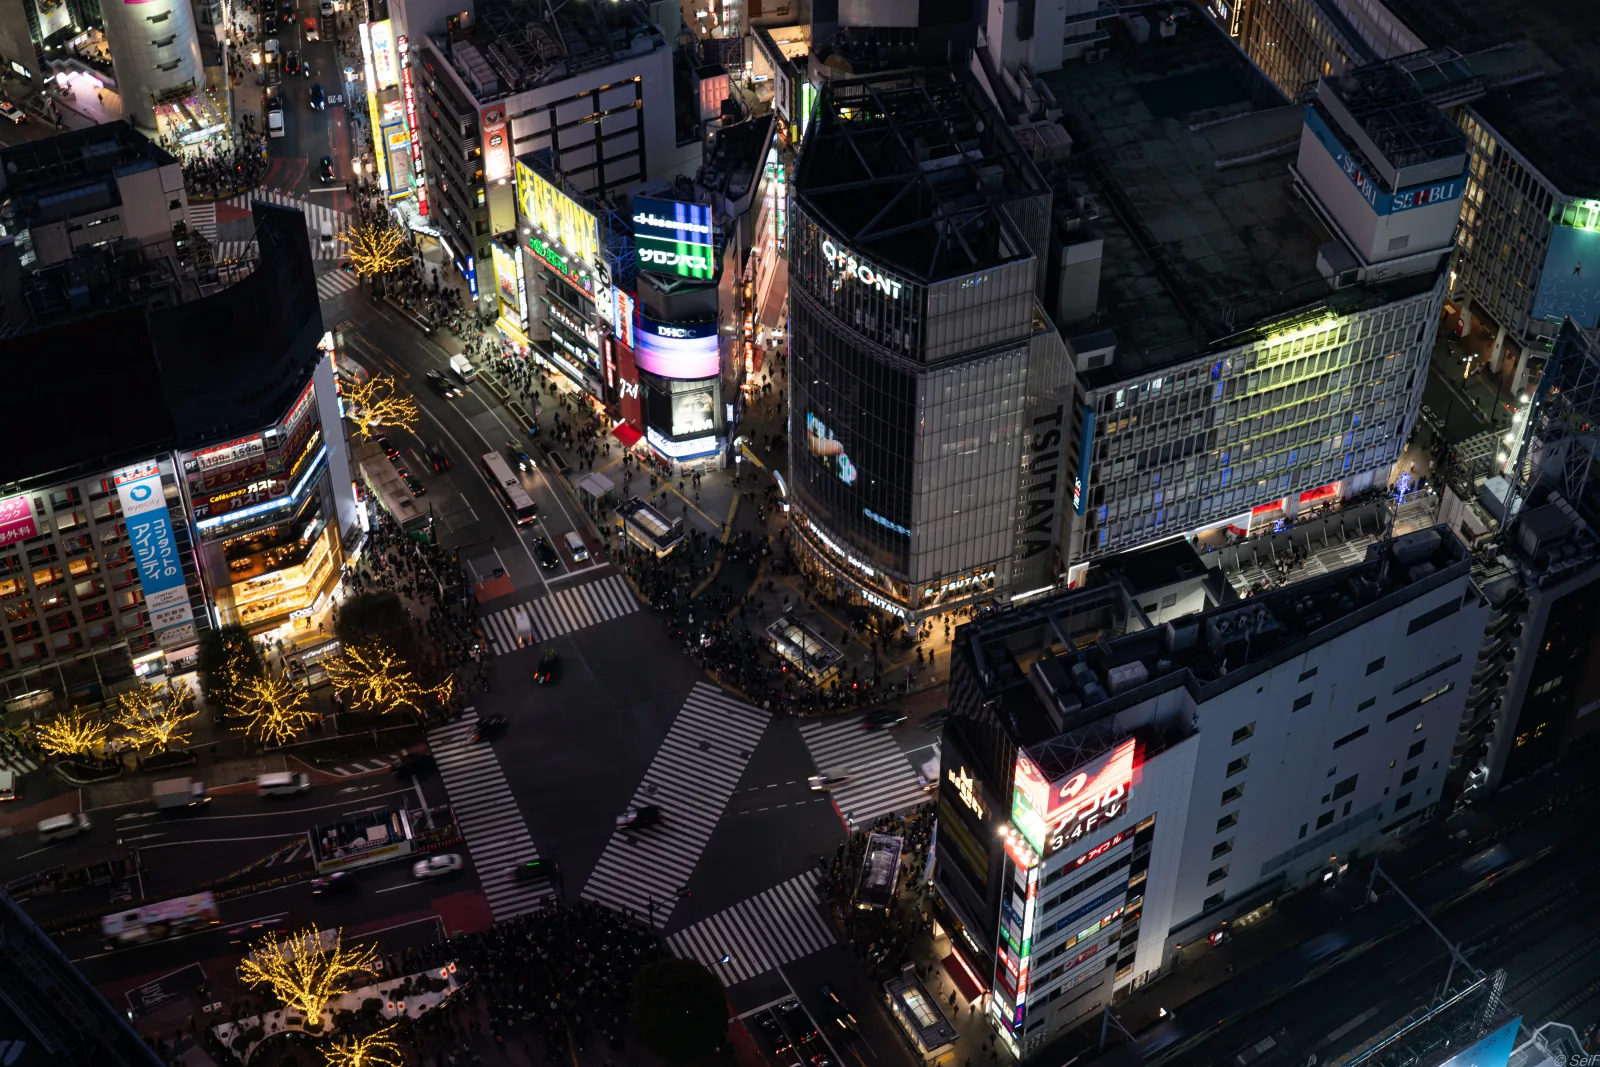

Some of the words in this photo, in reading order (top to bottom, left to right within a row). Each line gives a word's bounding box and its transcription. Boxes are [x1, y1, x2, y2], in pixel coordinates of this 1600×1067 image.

[1344, 155, 1377, 206] SEIBU
[516, 161, 595, 244] CEREMONY
[1392, 183, 1454, 211] SEIBU
[633, 212, 709, 234] Hisamitsu
[638, 248, 708, 271] サロンパス
[185, 460, 197, 470] 9F
[247, 479, 277, 494] ガスト
[1025, 404, 1064, 560] TSUTAYA
[195, 507, 208, 517] 7F
[132, 522, 162, 580] アイシティ
[153, 518, 177, 577] コンタクトの
[941, 570, 996, 593] TSUTAYA
[862, 589, 905, 619] TSUTAYA
[1054, 783, 1125, 834] アコム
[1088, 835, 1123, 860] アイフル
